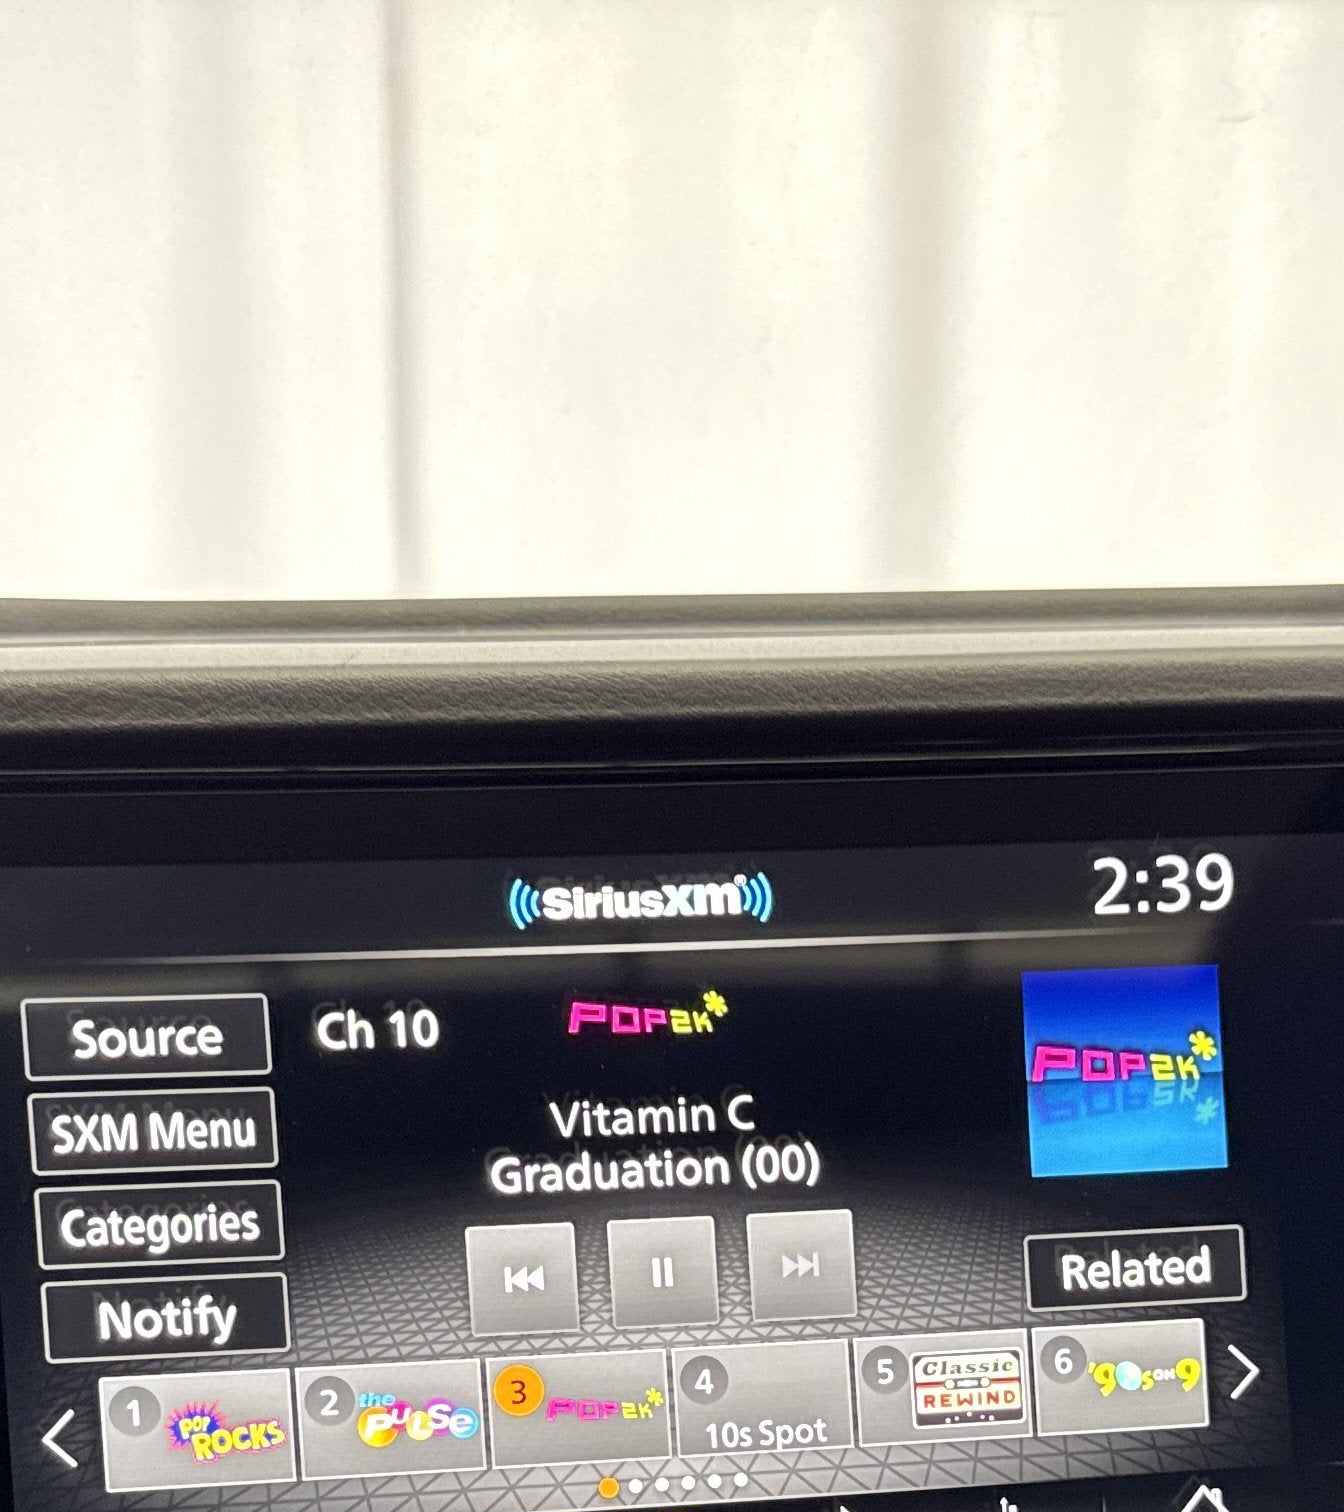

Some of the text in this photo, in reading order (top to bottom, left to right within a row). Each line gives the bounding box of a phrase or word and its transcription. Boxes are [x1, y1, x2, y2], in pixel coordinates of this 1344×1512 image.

[1092, 852, 1235, 915] 2:39
[72, 1019, 224, 1060] Source
[316, 1008, 441, 1052] Ch 10
[51, 1112, 257, 1155] SXM Menu
[549, 1095, 756, 1139] Vitamin C
[489, 1141, 821, 1195] Graduation (00)
[59, 1203, 260, 1254] Categories
[1061, 1244, 1212, 1291] Related
[98, 1295, 239, 1345] Notify
[876, 1358, 895, 1385] 5
[922, 1358, 1013, 1377] Classic
[1055, 1348, 1073, 1375] 6
[511, 1380, 527, 1404] 3
[694, 1368, 714, 1395] 4
[125, 1399, 142, 1427] 1
[319, 1389, 340, 1416] 2
[358, 1391, 396, 1408] the
[923, 1390, 1016, 1409] REWIND
[178, 1416, 212, 1440] POP
[192, 1420, 287, 1461] ROCKS
[704, 1419, 828, 1454] 10s Spot
